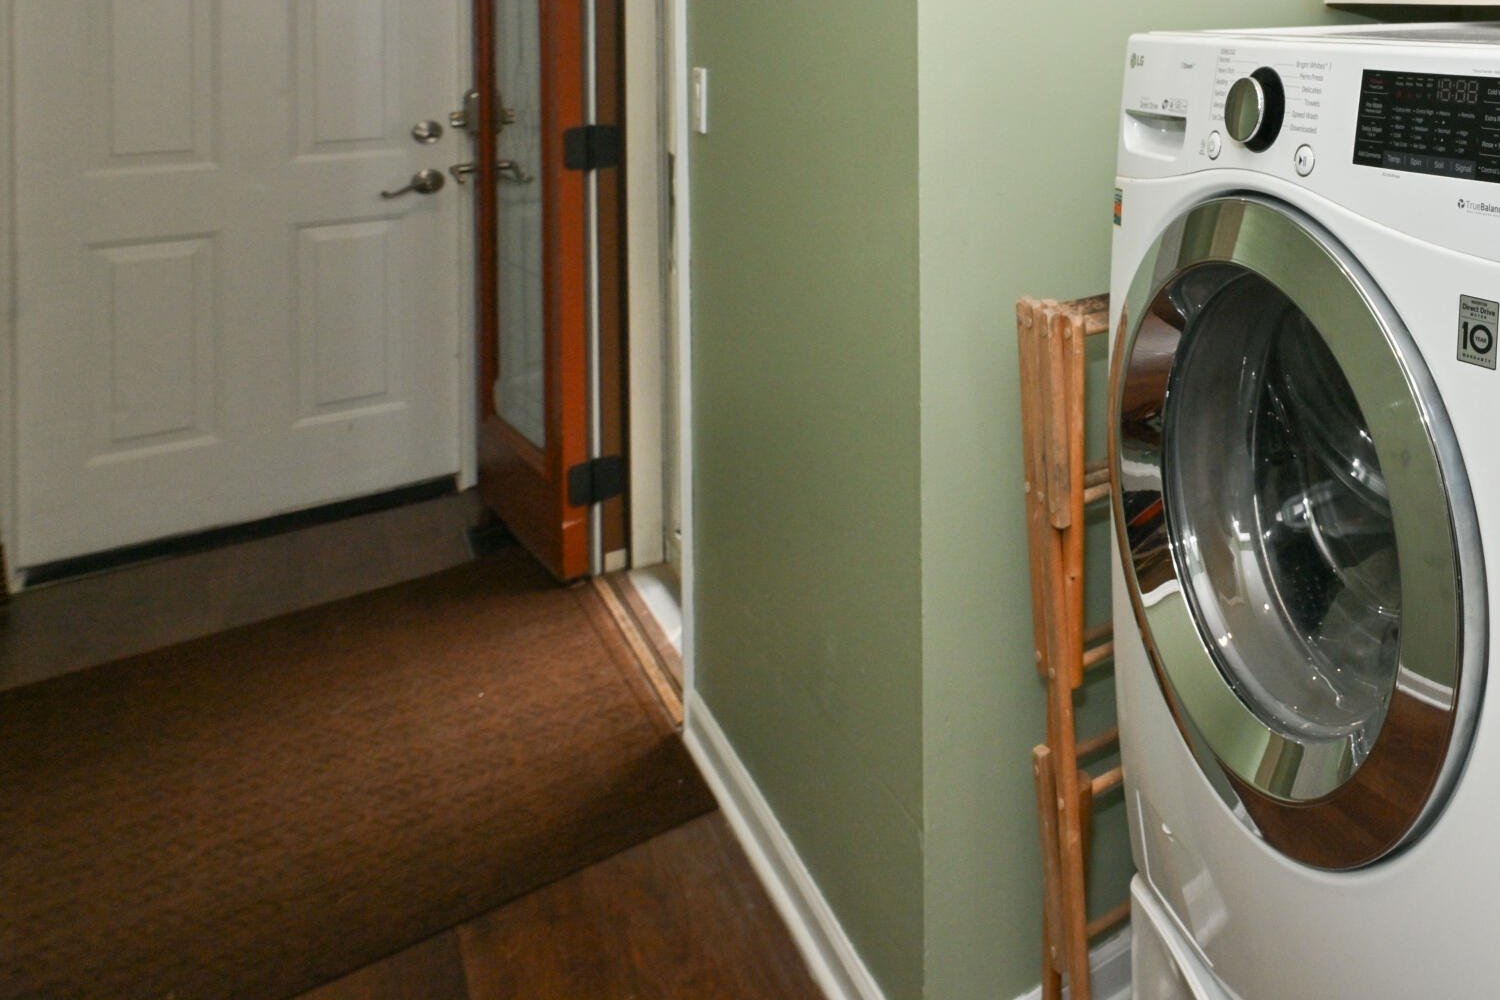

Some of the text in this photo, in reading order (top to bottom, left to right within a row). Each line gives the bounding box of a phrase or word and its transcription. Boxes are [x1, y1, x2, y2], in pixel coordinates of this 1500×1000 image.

[1462, 303, 1479, 313] Direct
[1480, 307, 1495, 316] Drive
[1462, 322, 1493, 354] 10
